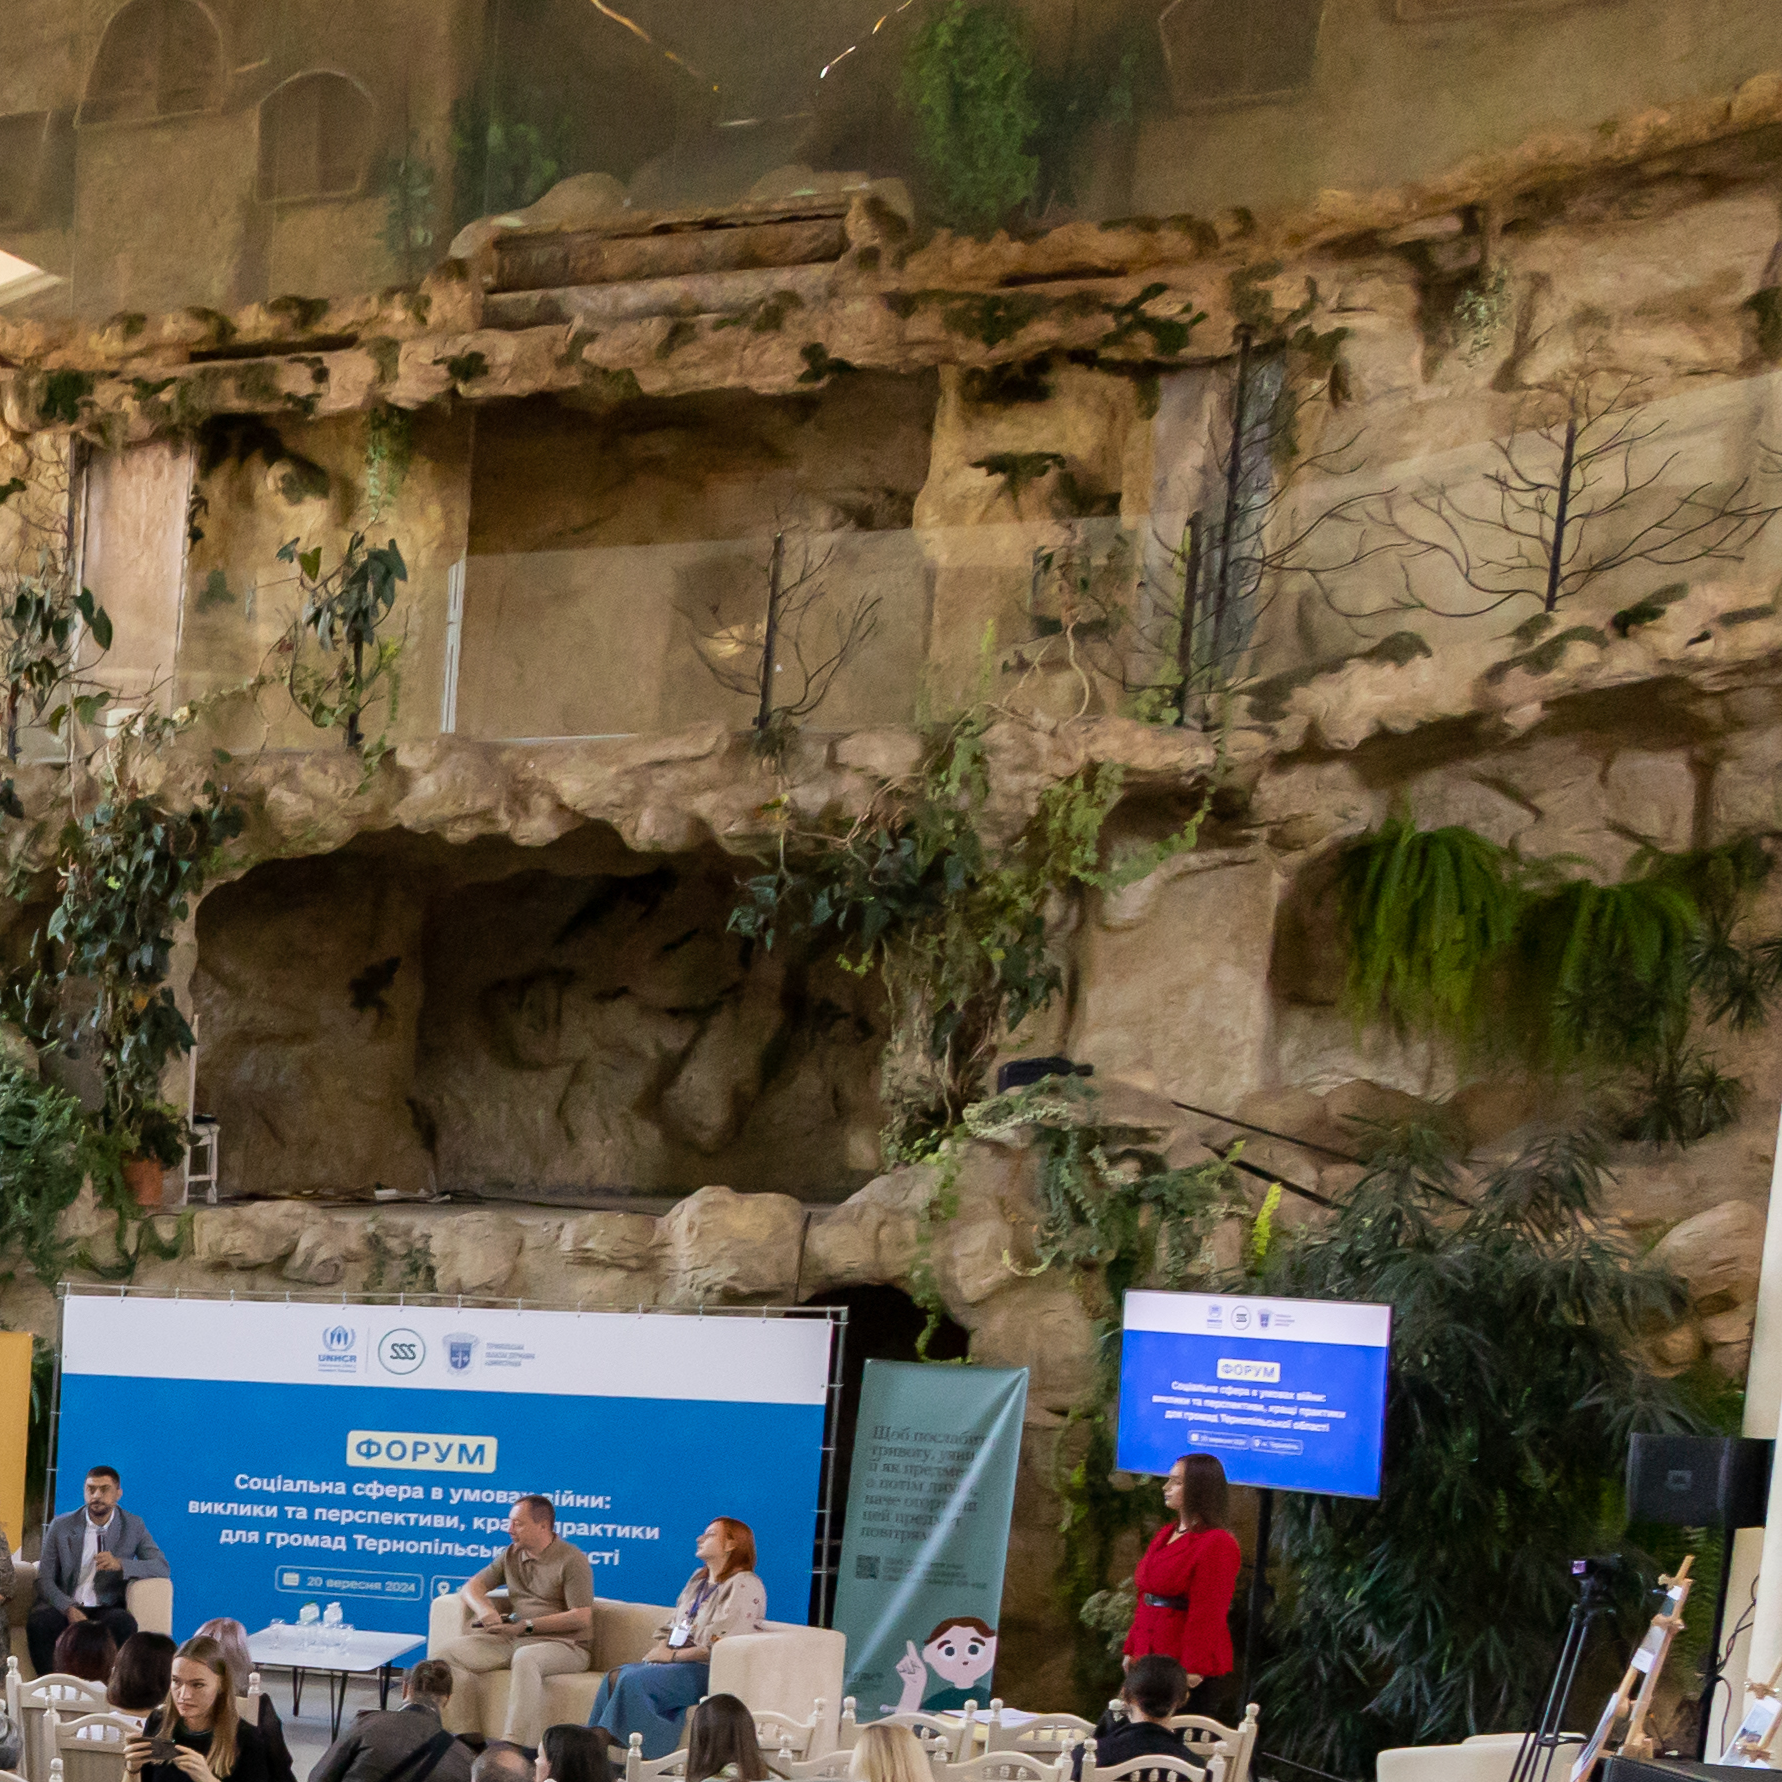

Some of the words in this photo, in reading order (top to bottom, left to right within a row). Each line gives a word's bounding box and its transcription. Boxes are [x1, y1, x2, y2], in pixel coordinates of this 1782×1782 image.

[318, 1354, 357, 1363] UNHCR
[390, 1343, 417, 1361] SSS
[1221, 1363, 1275, 1378] ФОРУМ
[873, 1426, 910, 1442] Щоб
[913, 1429, 993, 1446] послаби
[355, 1438, 486, 1466] ФОРУМ
[235, 1473, 346, 1496] Соціальна
[352, 1480, 424, 1501] сфера
[431, 1486, 443, 1500] в
[188, 1500, 278, 1518] виклики
[284, 1506, 308, 1520] та
[314, 1507, 466, 1532] перспективи,
[473, 1516, 512, 1534] кра
[554, 1521, 660, 1540] практики
[219, 1529, 260, 1545] для
[266, 1531, 347, 1551] громад
[353, 1534, 505, 1559] Тернопільськ
[860, 1527, 929, 1544] повітря
[307, 1577, 323, 1587] 20
[326, 1579, 382, 1591] вересня
[385, 1581, 416, 1593] 2024
